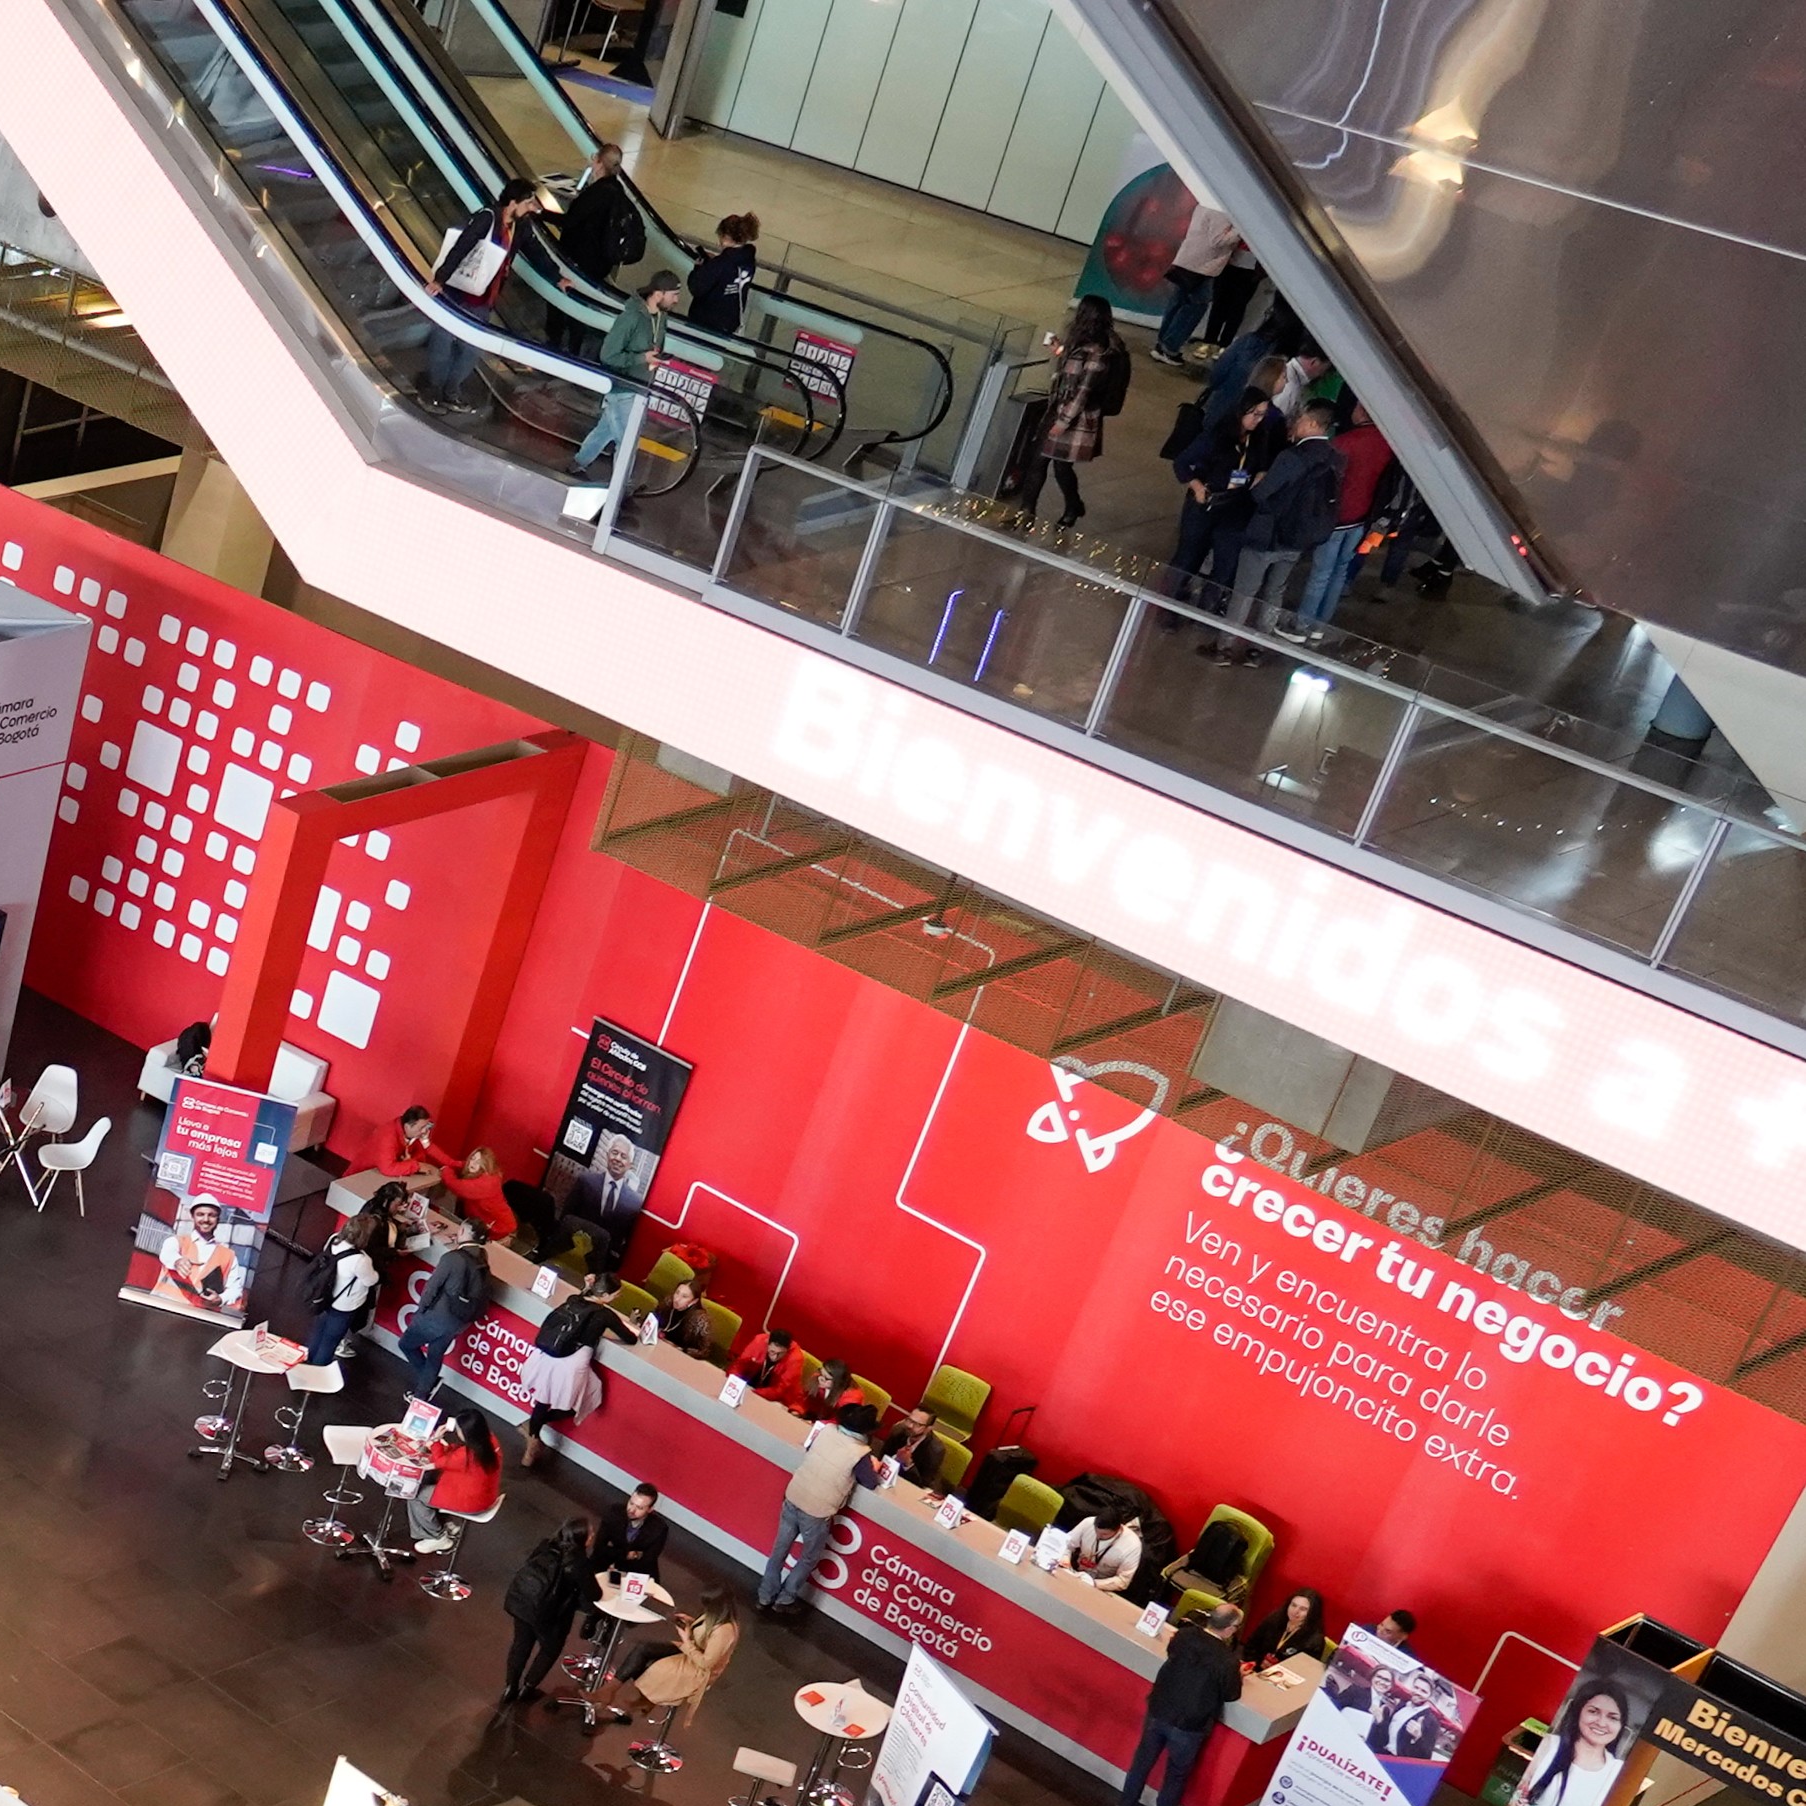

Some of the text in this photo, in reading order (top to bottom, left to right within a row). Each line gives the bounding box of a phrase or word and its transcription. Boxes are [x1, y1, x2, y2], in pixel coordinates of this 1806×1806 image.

[0, 706, 58, 732] Comercio
[771, 652, 1566, 1082] Bienvenidos
[1215, 1120, 1625, 1332] ¿Quieres hacer
[1184, 1211, 1488, 1392] Ven y encuentra lo
[1201, 1166, 1703, 1427] crecer tu negocio?
[467, 1333, 488, 1356] de
[1165, 1253, 1510, 1447] necesario para darle
[1150, 1289, 1518, 1500] ese empujoncito extra.
[861, 1565, 992, 1654] de Comercio
[869, 1544, 956, 1606] Cámara
[852, 1584, 960, 1661] de Bogotá
[1297, 1735, 1394, 1802] ¡DUALÍZATE!
[1653, 1718, 1784, 1798] Mercados
